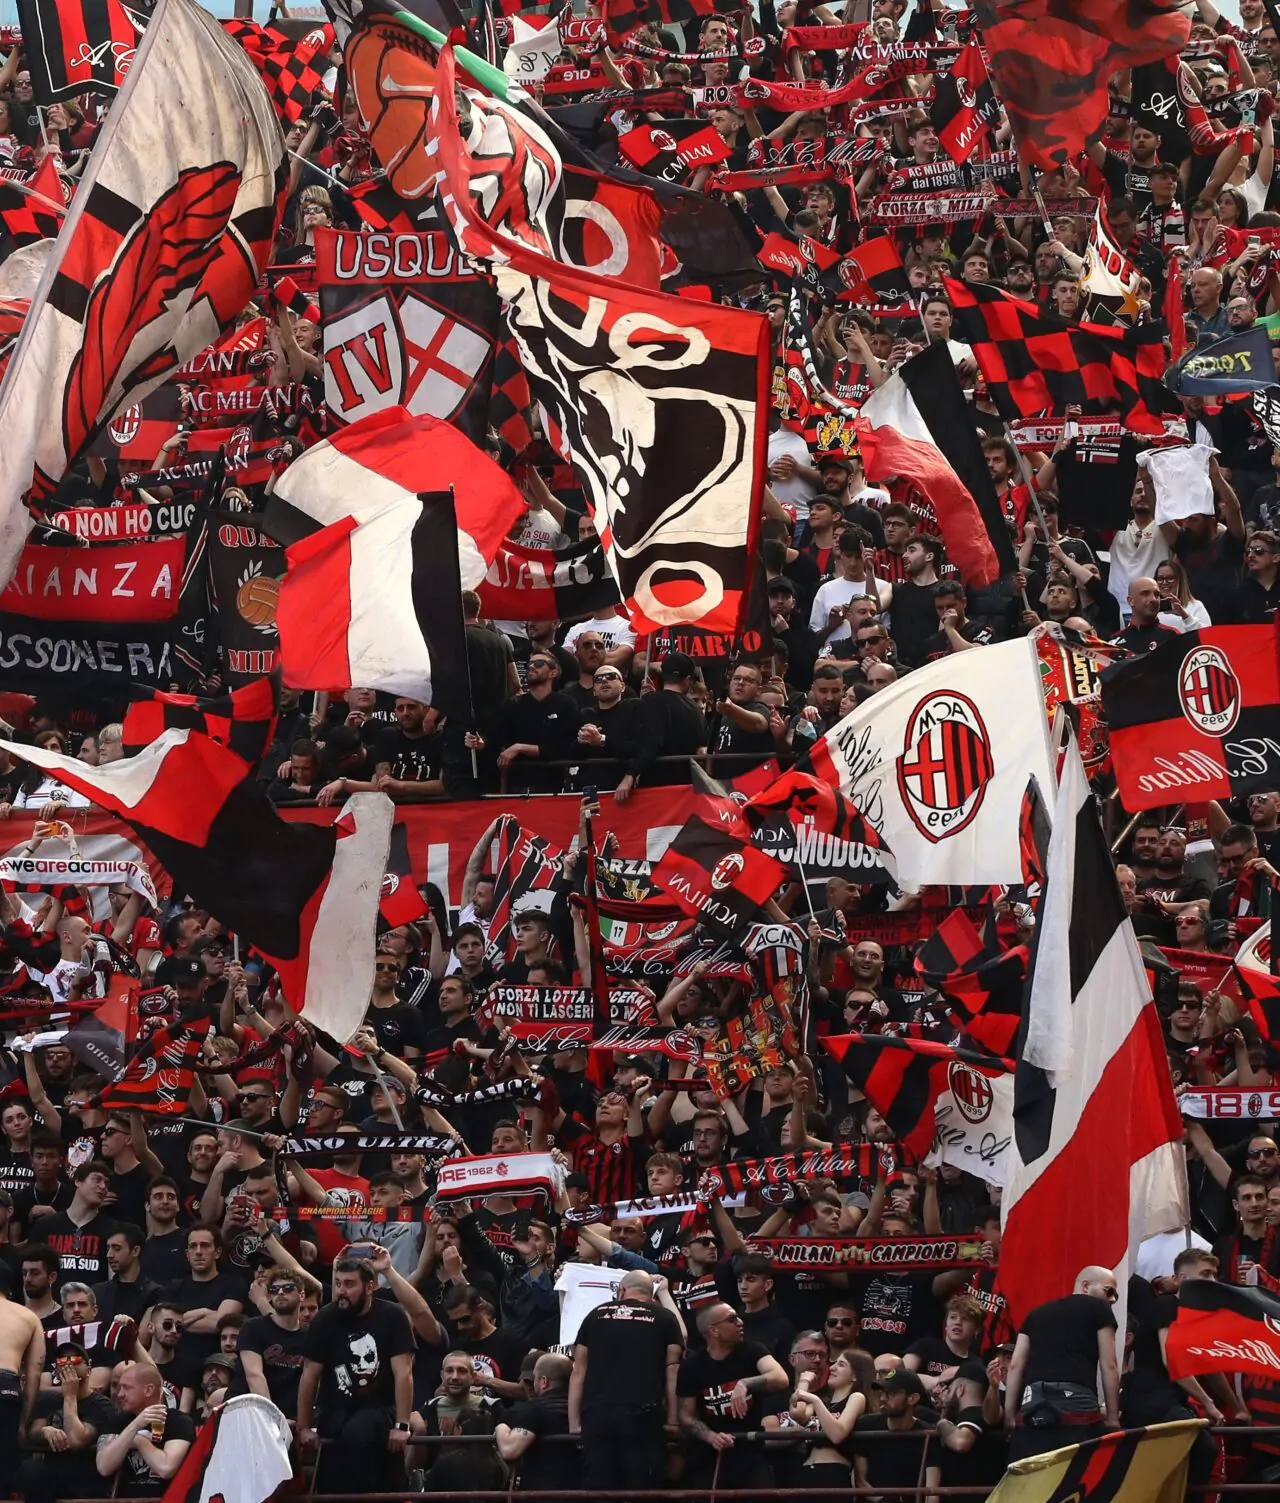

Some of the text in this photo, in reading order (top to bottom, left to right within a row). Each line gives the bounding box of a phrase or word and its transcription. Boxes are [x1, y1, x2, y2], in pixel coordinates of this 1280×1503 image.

[851, 44, 873, 61] AC
[892, 49, 928, 62] MILAN
[675, 142, 714, 170] MILAN
[821, 139, 885, 164] Milan
[907, 160, 957, 179] AC MILAN
[911, 173, 958, 190] dal 1899
[881, 200, 927, 216] FORZA
[947, 197, 985, 214] MILA
[176, 351, 236, 374] ILAN
[325, 322, 394, 413] IV
[184, 387, 291, 412] AC MILAN
[114, 431, 131, 441] 1899
[1035, 426, 1084, 441] FORA
[156, 466, 183, 482] AC
[75, 509, 118, 538] NON
[125, 507, 153, 534] HO
[532, 530, 550, 542] SUD
[611, 925, 624, 939] 17
[756, 927, 797, 946] ACM
[498, 988, 586, 1002] FORZA LOTTA
[495, 1004, 539, 1018] NON TI
[581, 1025, 663, 1050] Milan
[962, 1103, 984, 1116] 1899
[1200, 1093, 1243, 1118] 18
[799, 1150, 856, 1175] Milan
[467, 1166, 494, 1177] 1962
[300, 1207, 385, 1217] CHAMPIONS LEAGUE
[779, 1241, 957, 1264] MILAN CAMPIONE
[76, 1258, 99, 1272] SUD
